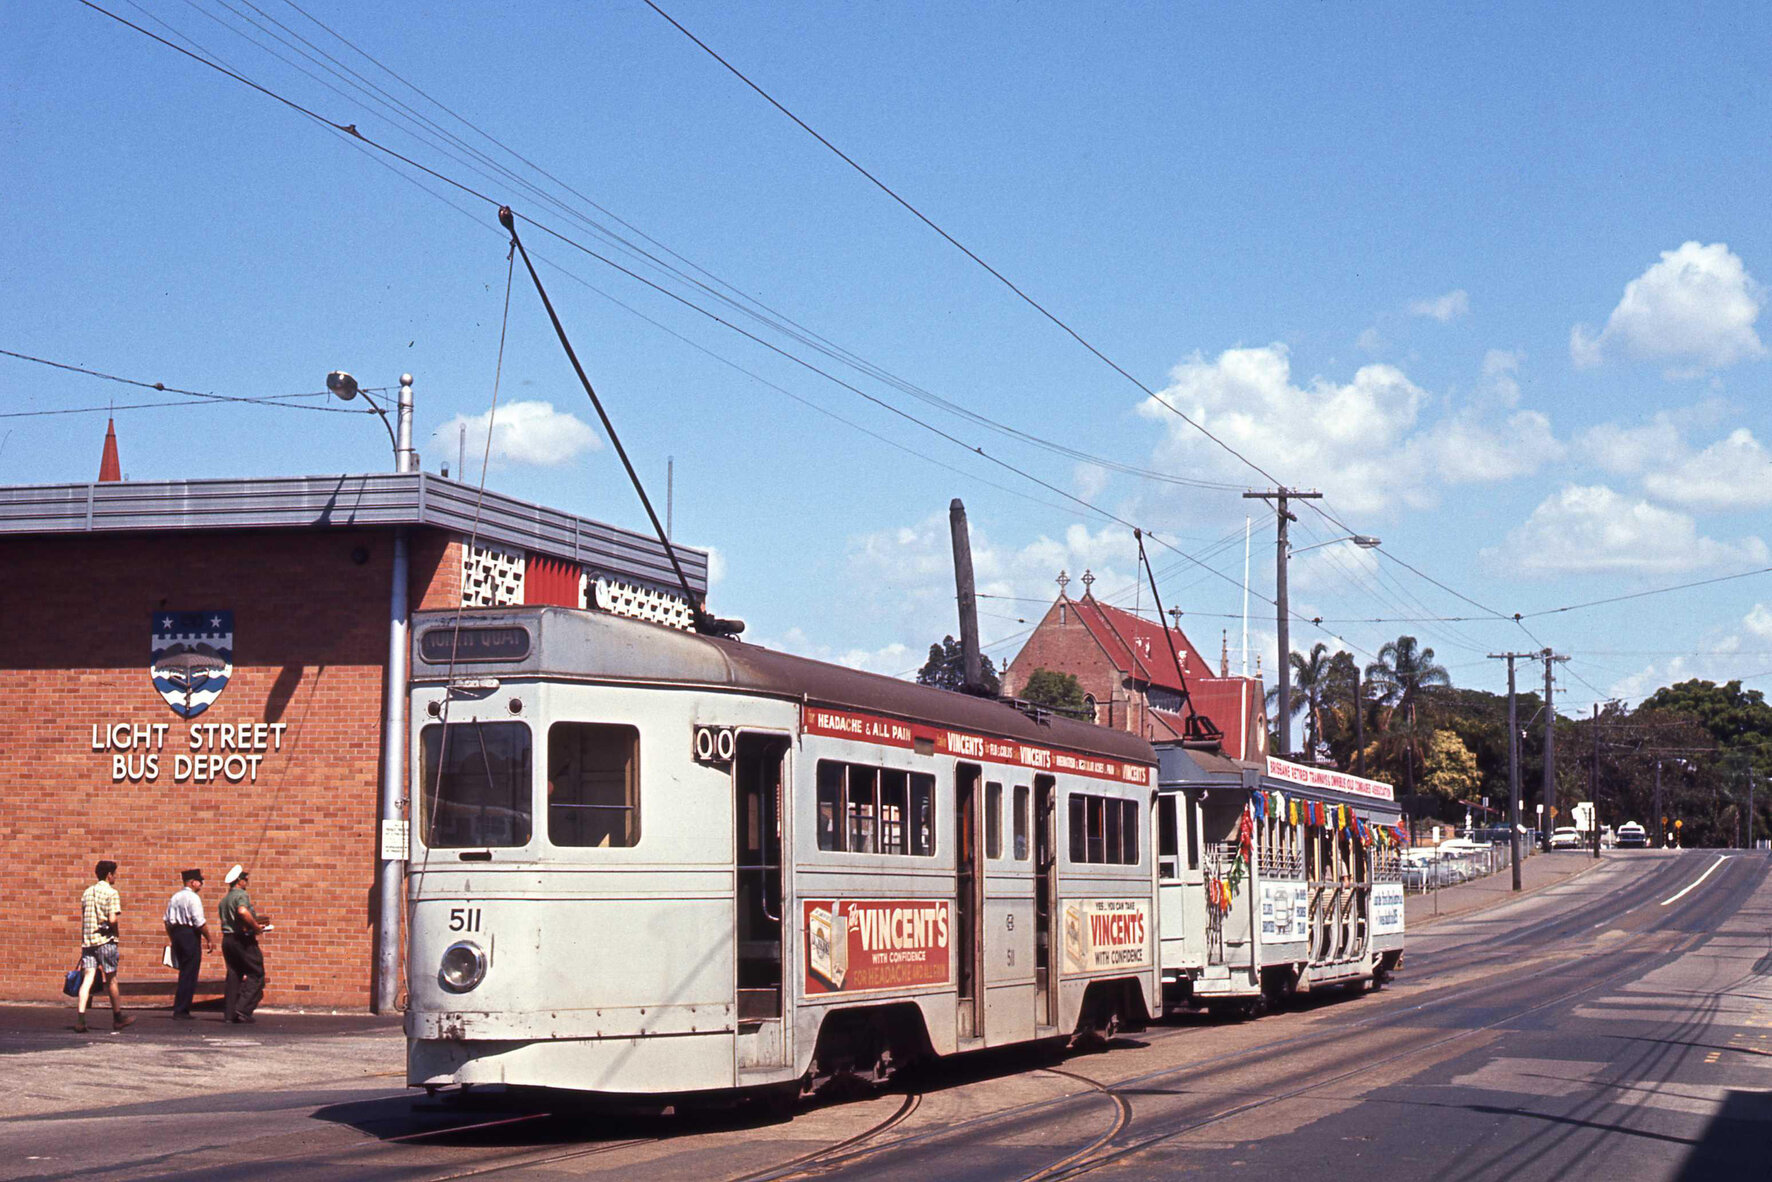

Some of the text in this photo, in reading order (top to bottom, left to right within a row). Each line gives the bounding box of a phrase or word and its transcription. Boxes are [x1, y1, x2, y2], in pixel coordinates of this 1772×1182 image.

[92, 723, 287, 749] LIGHT STREET
[818, 713, 862, 733] HEADACHE
[865, 723, 871, 736] &
[872, 723, 889, 738] ALL
[892, 725, 911, 742] PAIN
[947, 732, 984, 757] VINCENT'S
[112, 754, 263, 780] BUS DEPOT
[1116, 901, 1124, 910] CAN
[449, 908, 481, 932] 511
[858, 902, 948, 951] VINCENT'S
[1090, 908, 1145, 947] VINCENT'S
[872, 950, 926, 964] WITH CONFIDENCE
[1095, 948, 1143, 966] WITH CONFIDENCE
[854, 969, 867, 986] FOR
[868, 964, 912, 985] HEADACHE
